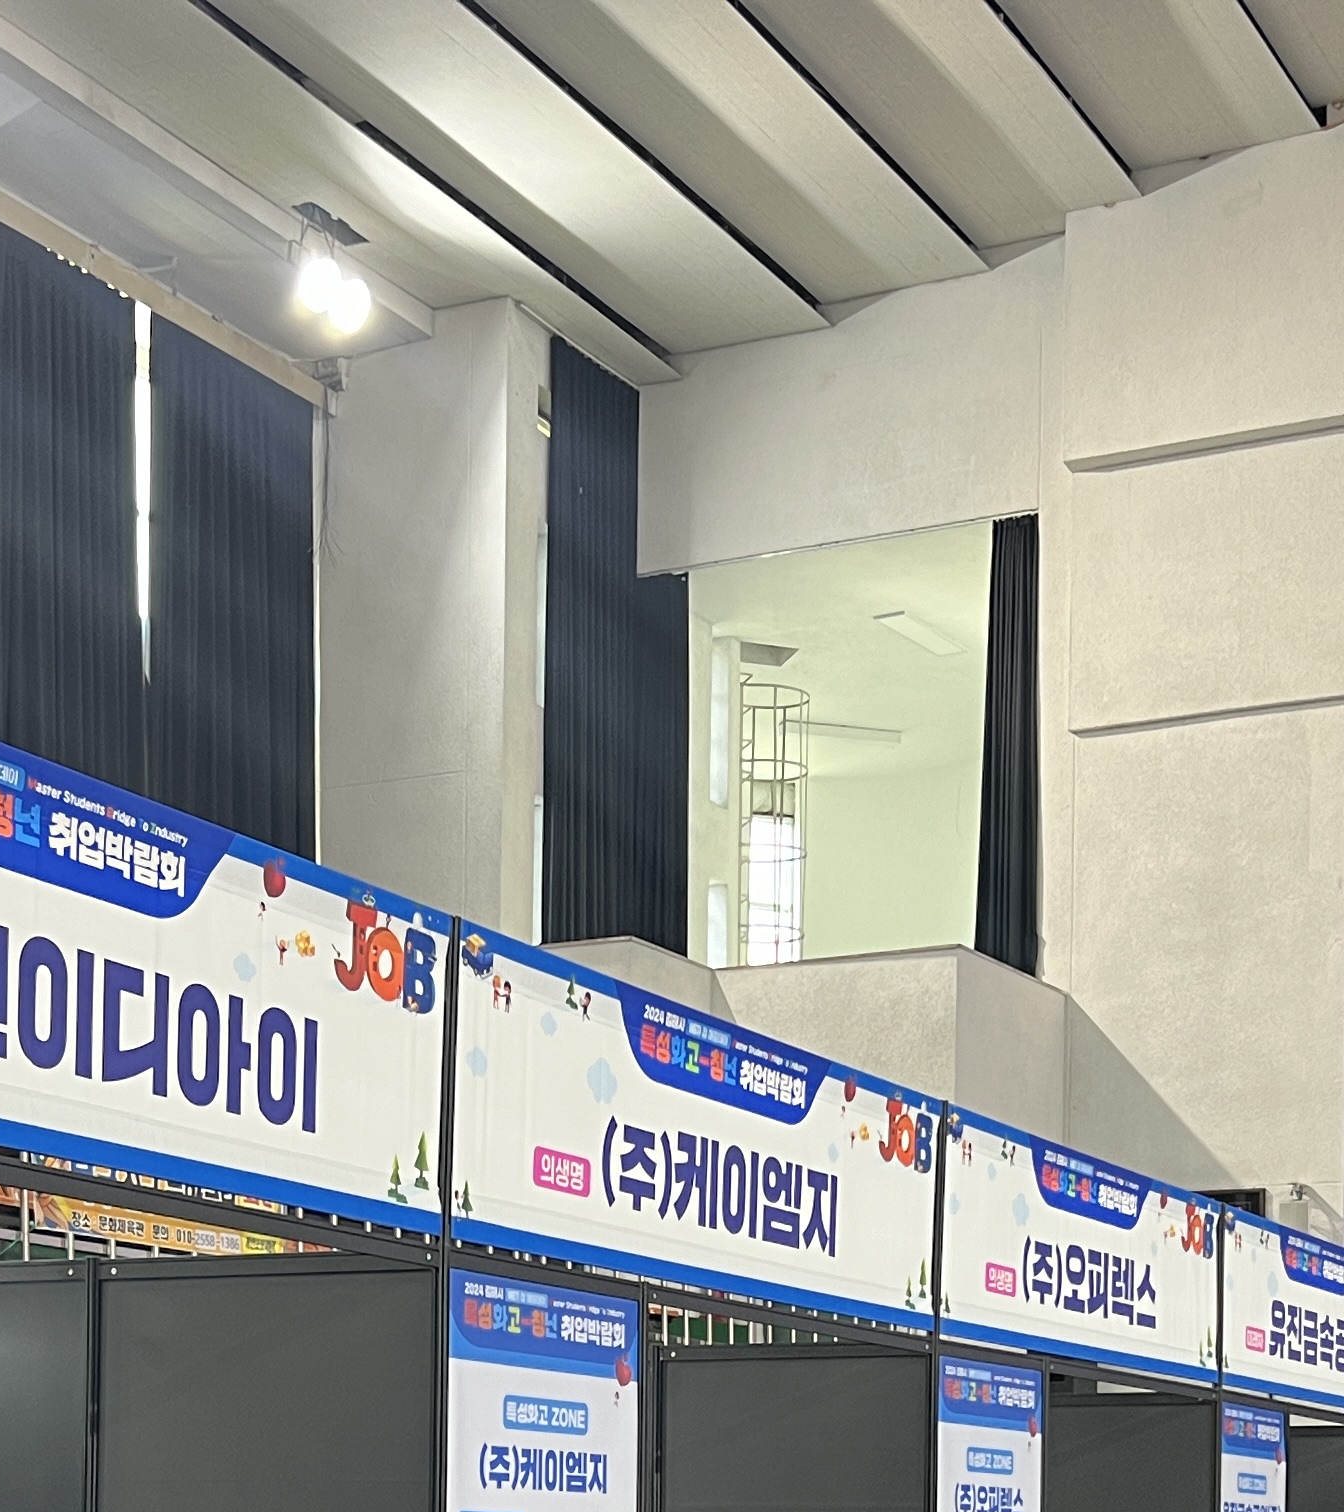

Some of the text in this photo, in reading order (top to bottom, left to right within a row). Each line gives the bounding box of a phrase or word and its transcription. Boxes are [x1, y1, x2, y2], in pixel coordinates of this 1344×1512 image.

[63, 790, 106, 816] Students
[150, 821, 189, 847] Industry
[48, 811, 186, 898] 취업박람회
[332, 898, 437, 1014] JOB
[739, 1059, 807, 1109] 취업박람회
[878, 1097, 933, 1174] JOB
[540, 1116, 839, 1258] 의생명 (주)케이엠지
[70, 1210, 92, 1230] 장소
[98, 1215, 145, 1237] 문화체육관
[152, 1223, 170, 1242] 문의
[1022, 1234, 1157, 1330] (주)오피렉스
[560, 1315, 626, 1349] 취업박람회
[551, 1407, 586, 1430] ZONE
[479, 1442, 608, 1494] (주)케이엠지
